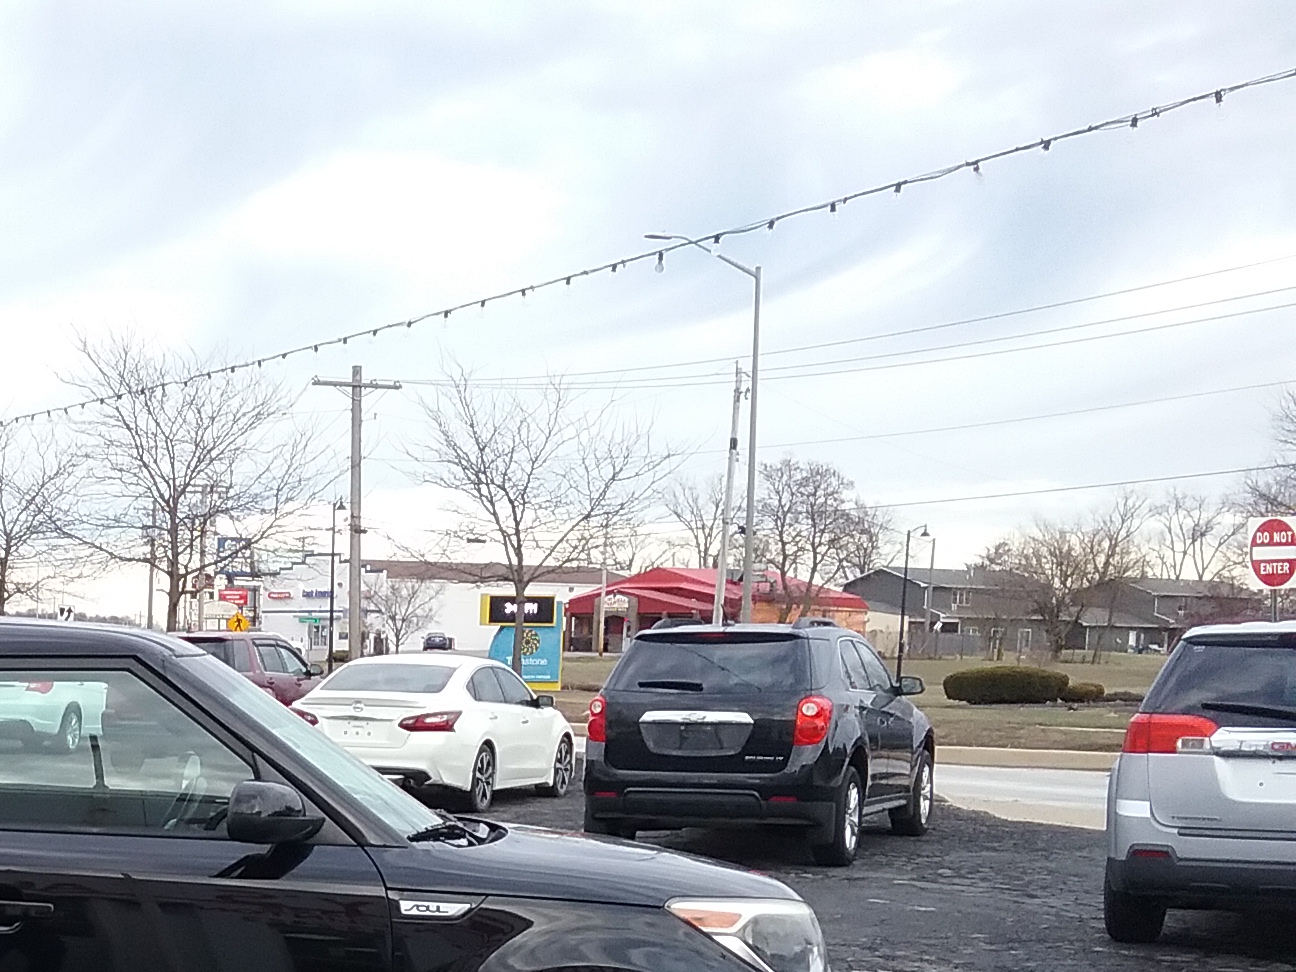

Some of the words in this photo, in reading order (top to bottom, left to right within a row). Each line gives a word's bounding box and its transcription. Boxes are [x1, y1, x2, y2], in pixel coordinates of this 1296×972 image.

[1256, 531, 1270, 544] DO
[1273, 531, 1293, 543] NOT
[1260, 562, 1290, 575] ENTER
